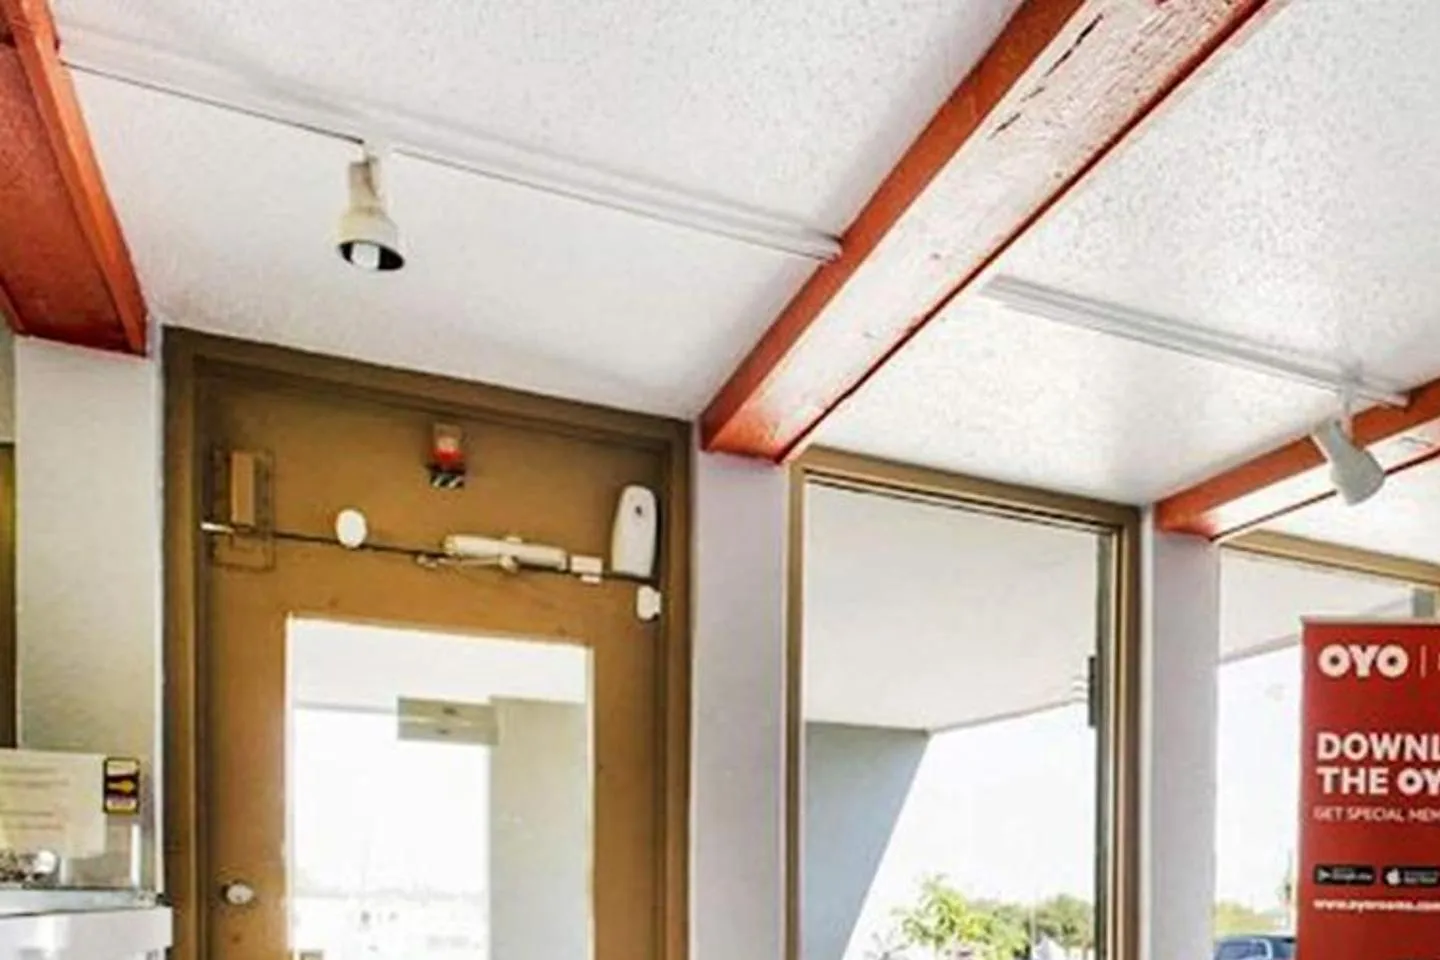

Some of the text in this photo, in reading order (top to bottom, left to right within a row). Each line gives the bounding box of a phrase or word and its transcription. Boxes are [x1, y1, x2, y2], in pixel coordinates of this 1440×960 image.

[1318, 644, 1409, 678] OYO
[1316, 766, 1389, 795] THE
[1313, 806, 1343, 822] GET
[1346, 806, 1405, 823] SPECIAL
